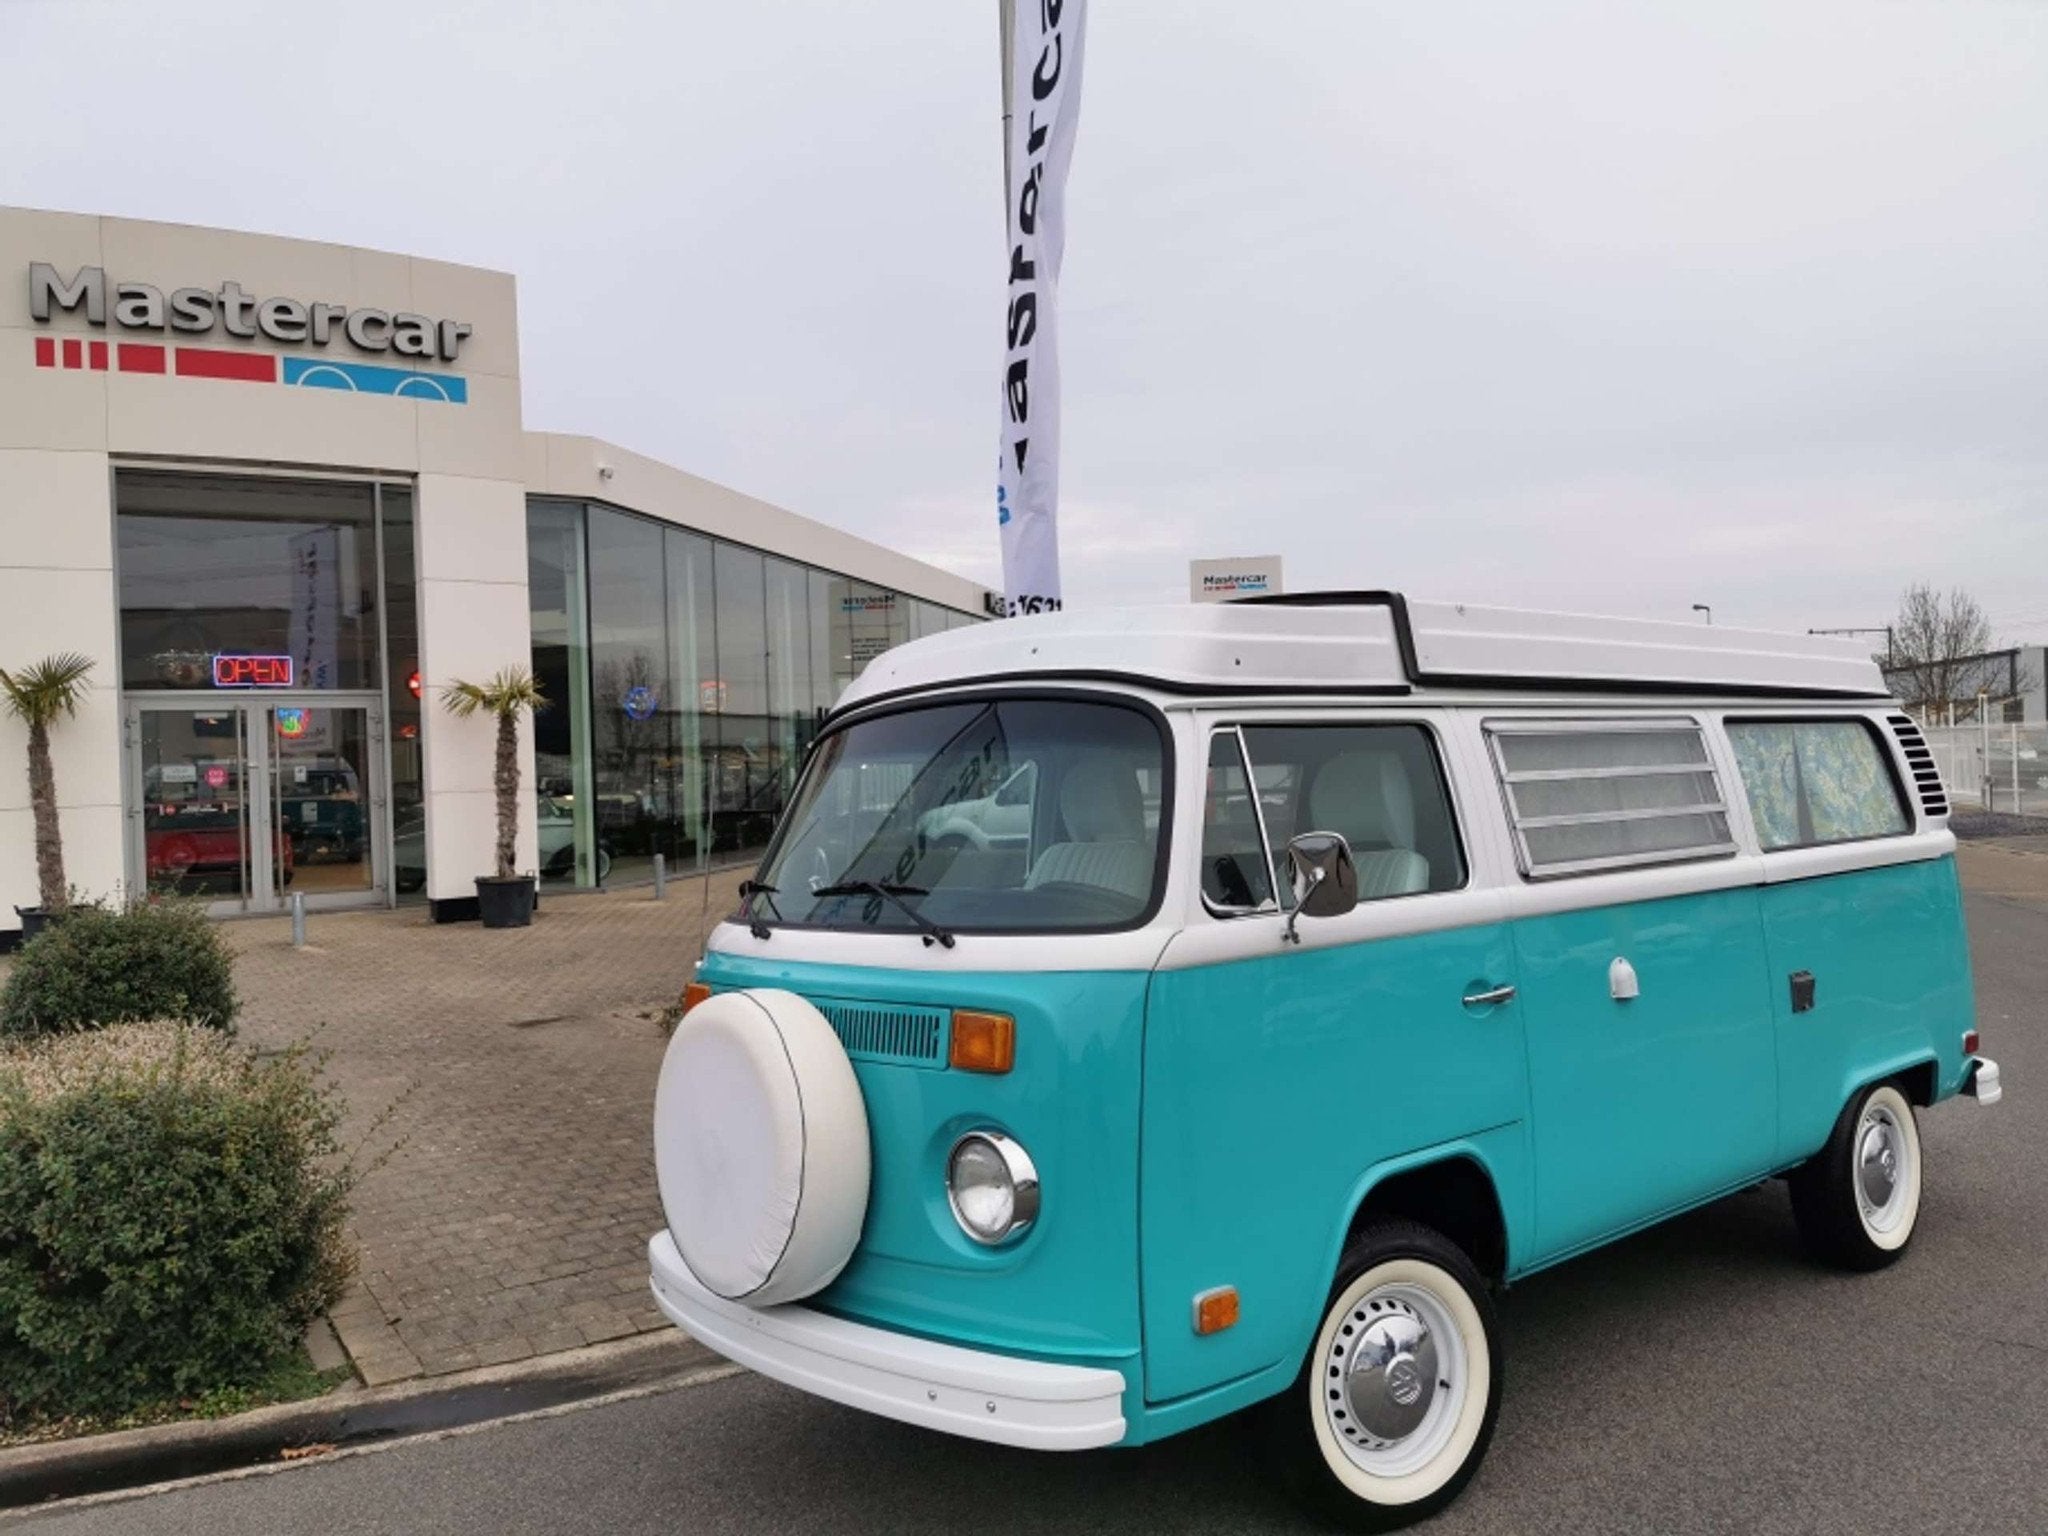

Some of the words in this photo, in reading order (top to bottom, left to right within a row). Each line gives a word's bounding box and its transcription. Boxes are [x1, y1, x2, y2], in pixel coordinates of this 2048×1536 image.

[28, 261, 473, 362] Mastercar
[1203, 574, 1267, 585] Mastercar
[217, 659, 290, 682] OPEN
